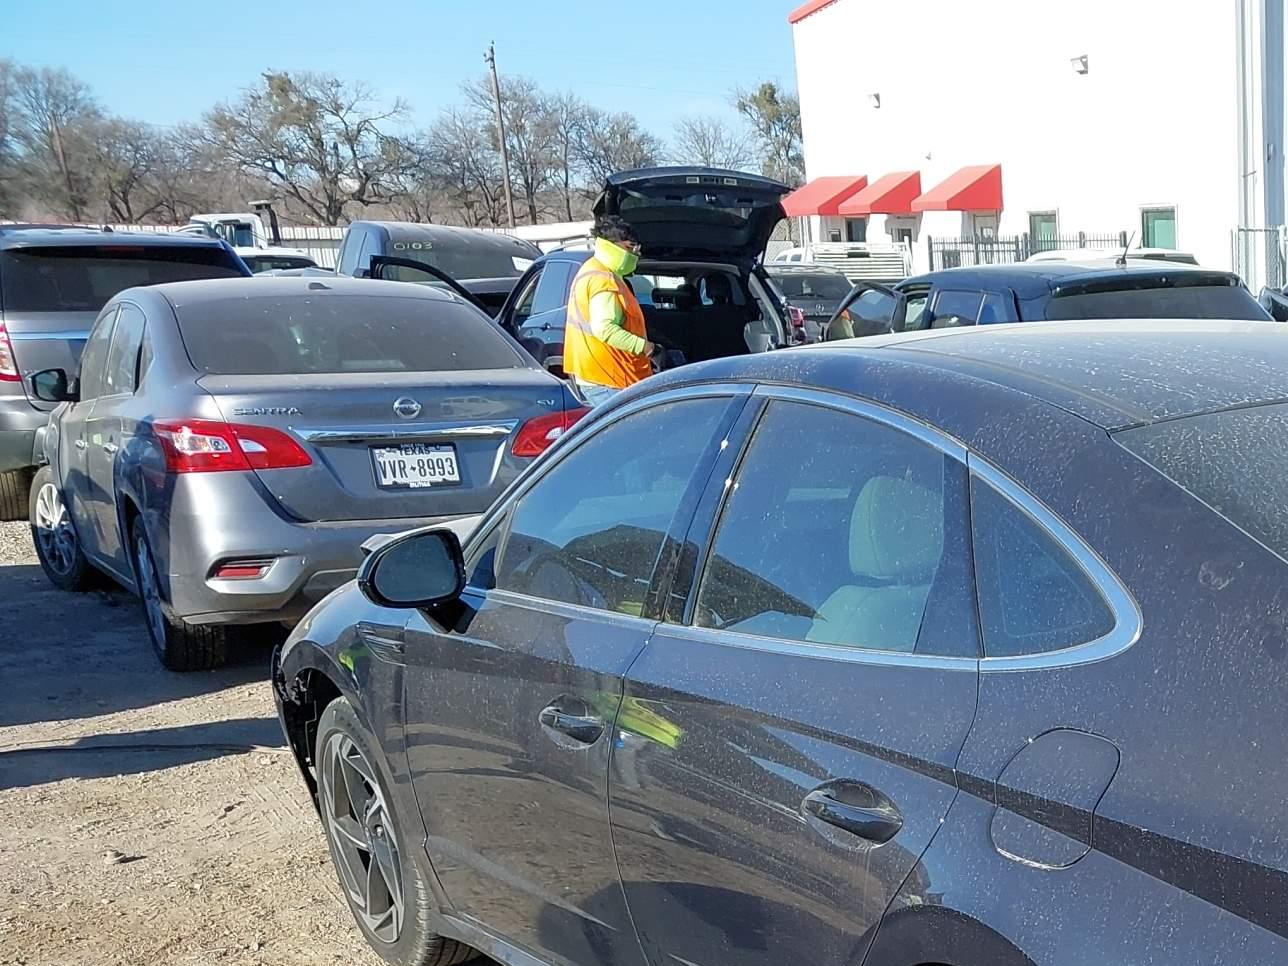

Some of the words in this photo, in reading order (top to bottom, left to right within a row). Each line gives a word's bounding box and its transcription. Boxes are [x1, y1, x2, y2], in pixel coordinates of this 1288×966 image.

[232, 407, 303, 416] SENTRA
[398, 446, 431, 456] TEXAS
[416, 457, 456, 478] 8993
